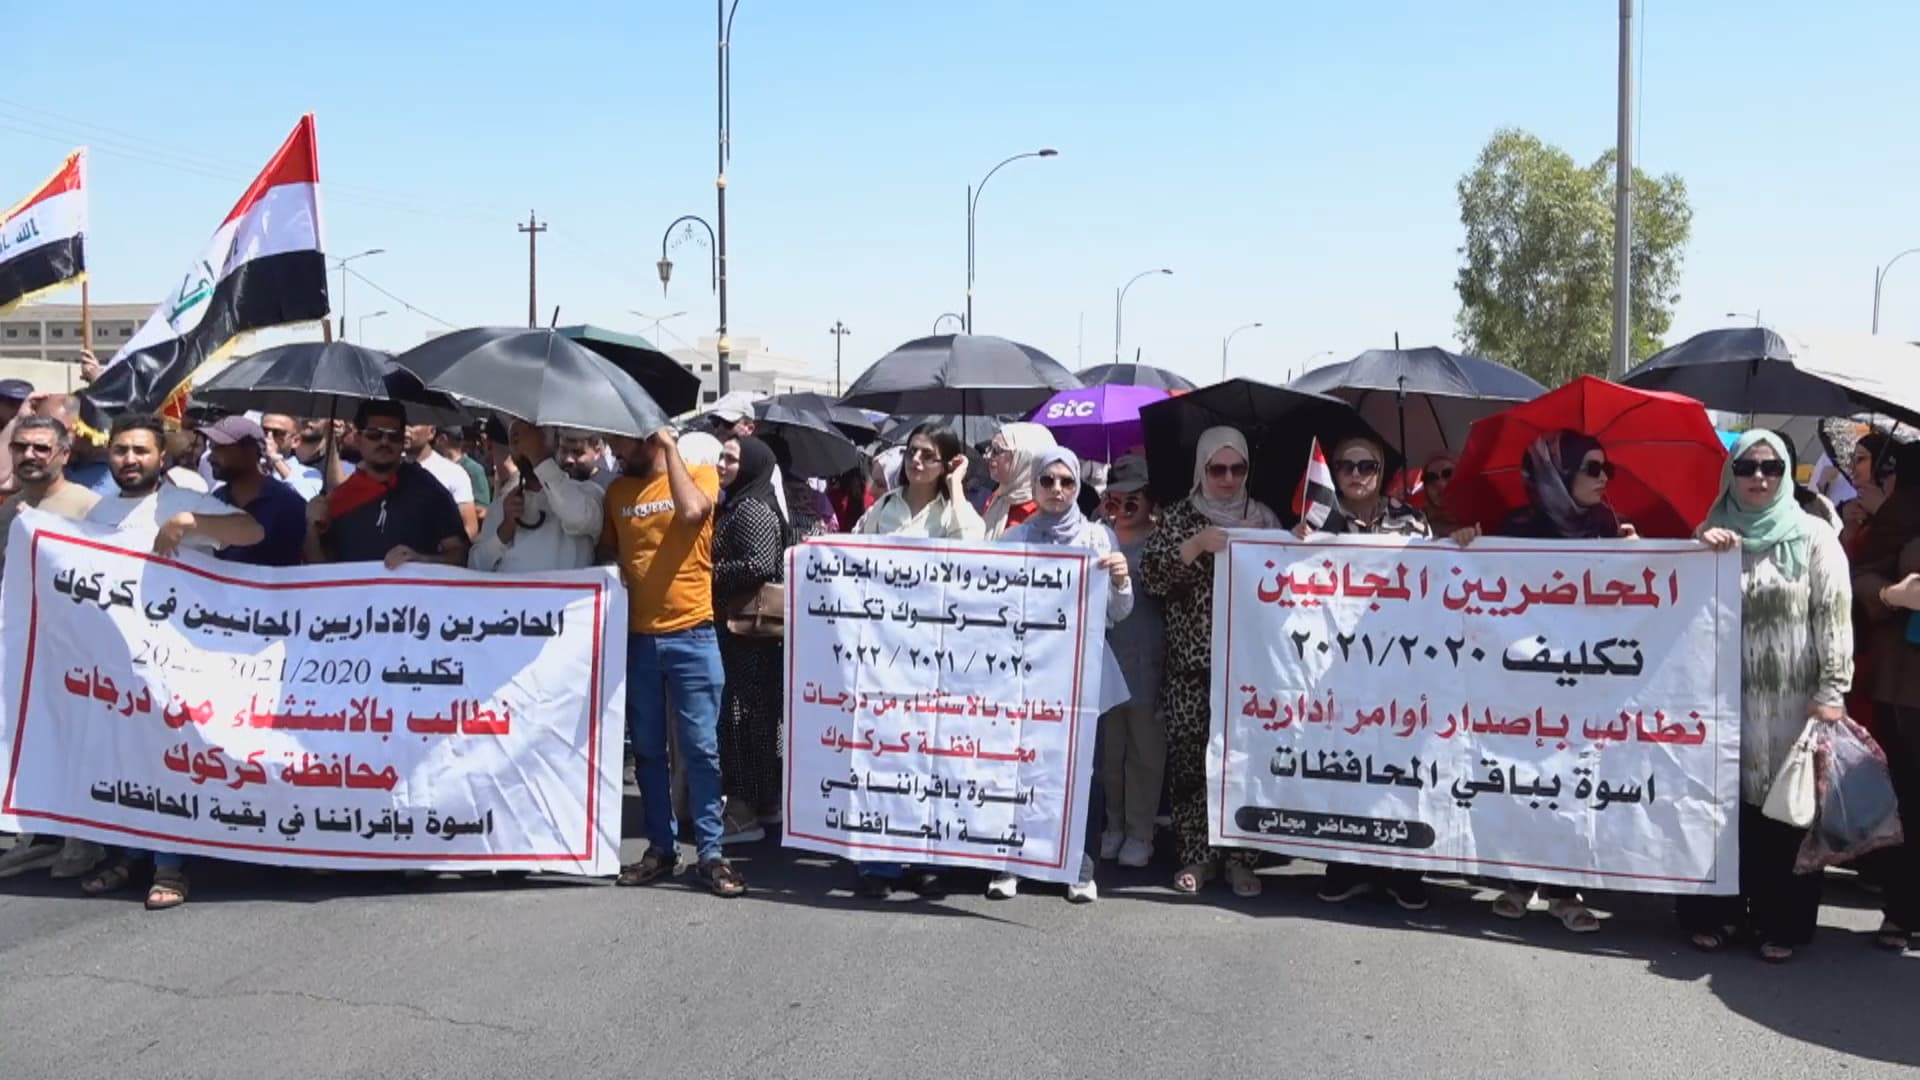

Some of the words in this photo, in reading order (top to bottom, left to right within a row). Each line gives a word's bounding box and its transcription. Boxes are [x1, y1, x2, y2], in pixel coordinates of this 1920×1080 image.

[1047, 399, 1096, 419] stc
[806, 555, 878, 583] المجانيين
[884, 560, 971, 590] والاداريين
[977, 565, 1071, 594] المحاضرين
[1257, 559, 1428, 612] المجانيين
[53, 568, 137, 611] كركوك
[144, 587, 177, 628] في
[1442, 566, 1678, 617] المحاضريين
[183, 604, 301, 642] المجانيين
[308, 604, 431, 643] والاداريين
[440, 608, 565, 643] المحاضرين
[808, 595, 885, 625] تكليف
[891, 600, 1009, 632] كركوك
[1013, 607, 1066, 641] في
[381, 655, 464, 692] تكليف
[1502, 635, 1644, 687] تكليف
[64, 665, 151, 717] درجات
[803, 682, 868, 713] درجات
[873, 691, 898, 715] من
[904, 688, 999, 726] بالاستثناء
[163, 693, 215, 729] من
[231, 694, 394, 742] بالاستثناء
[407, 699, 510, 742] نطالب
[1005, 700, 1065, 726] نطالب
[1344, 693, 1428, 737] أوامر
[1435, 701, 1569, 751] بإصدار
[1582, 708, 1706, 750] نطالب
[821, 725, 911, 757] كركوك
[917, 731, 1036, 762] محافظة
[164, 742, 267, 790] كركوك
[280, 751, 399, 793] محافظة
[820, 768, 859, 799] في
[1270, 746, 1438, 790] المحافظات
[1451, 757, 1562, 811] بباقي
[91, 779, 200, 821] المحافظات
[866, 771, 962, 808] باقراننا
[966, 780, 1034, 808] اسوة
[209, 797, 266, 833] بقية
[277, 804, 305, 841] في
[314, 807, 414, 841] بإقراننا
[425, 808, 494, 841] اسوة
[825, 807, 950, 841] المحافظات
[1257, 811, 1306, 833] مجاني
[1314, 818, 1367, 836] محاضر
[1373, 818, 1409, 843] ثورة
[958, 818, 1025, 857] بقية
